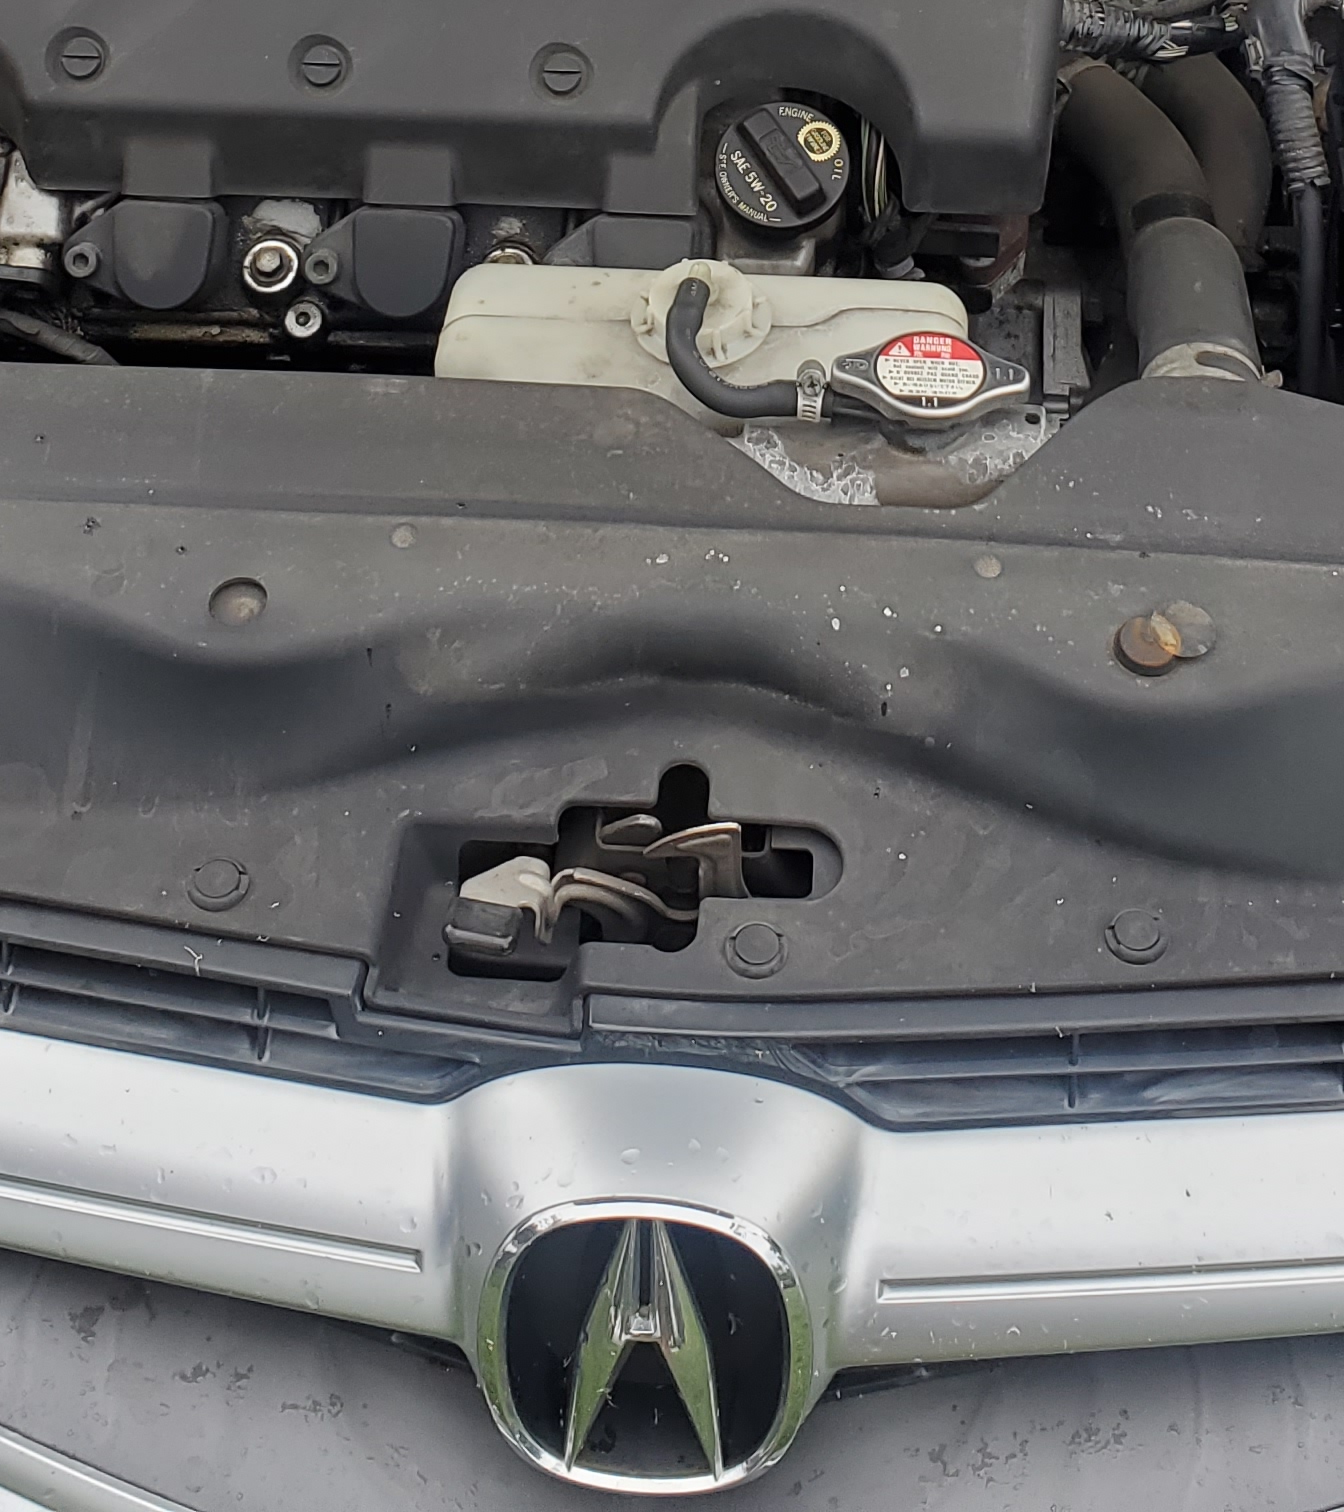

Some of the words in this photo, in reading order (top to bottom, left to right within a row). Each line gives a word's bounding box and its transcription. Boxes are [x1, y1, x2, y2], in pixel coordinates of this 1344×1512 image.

[779, 106, 815, 123] ENGINE
[832, 159, 844, 180] OIL
[730, 150, 751, 174] SAE
[744, 170, 778, 212] 5W-20
[719, 172, 740, 204] OWNER'S
[738, 202, 769, 222] MANUAL
[913, 335, 952, 344] DANGER
[913, 344, 952, 353] WARNUNG
[995, 367, 1014, 381] 1.1
[921, 396, 938, 407] 1.1
